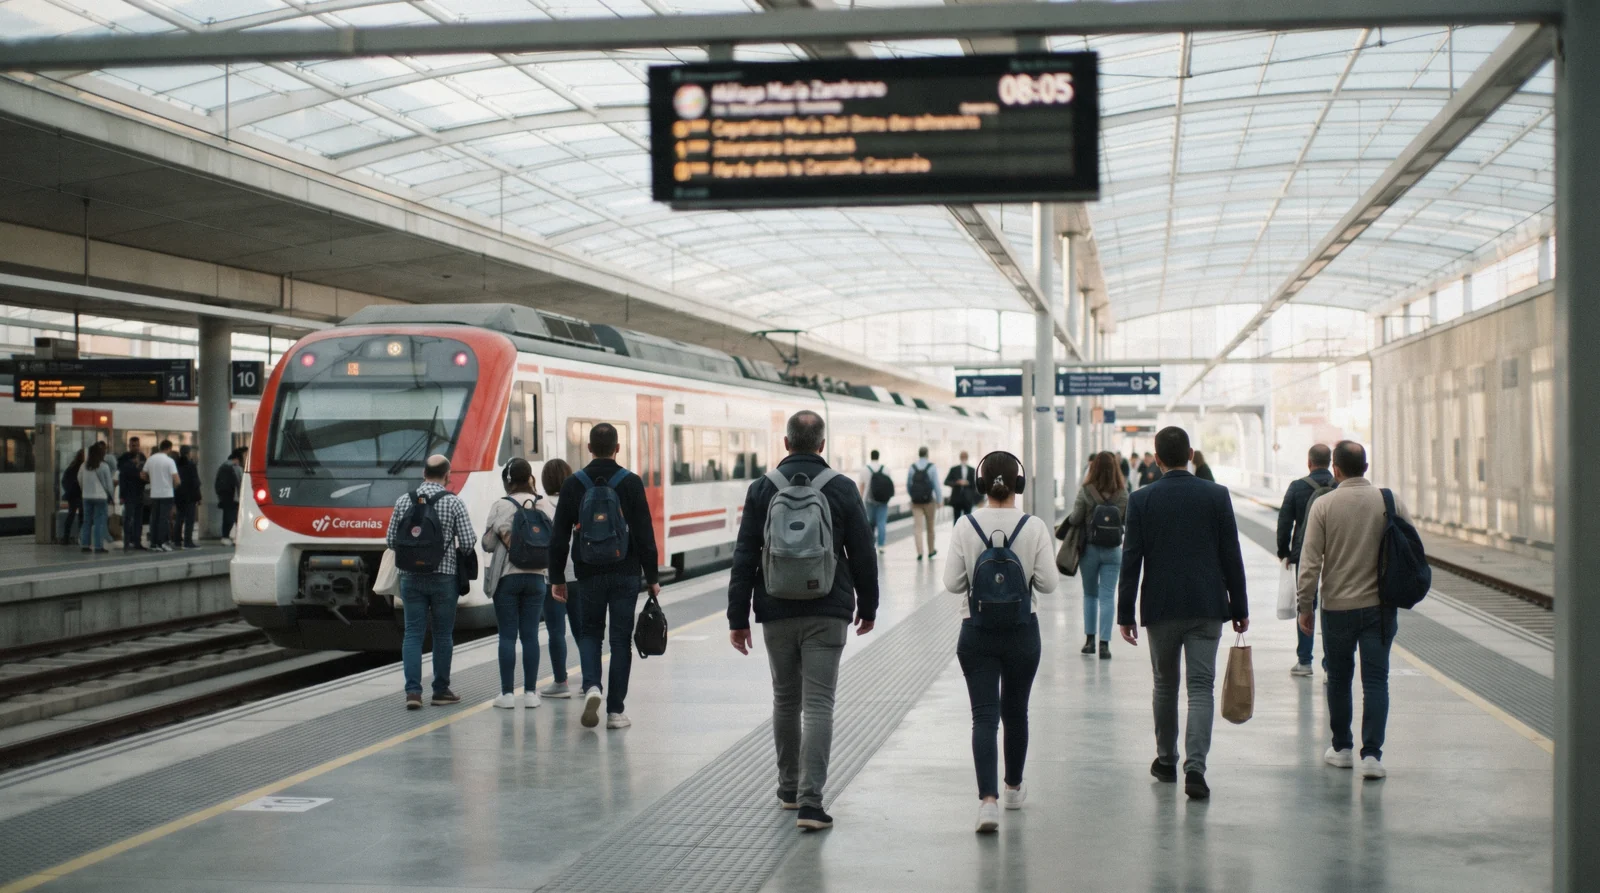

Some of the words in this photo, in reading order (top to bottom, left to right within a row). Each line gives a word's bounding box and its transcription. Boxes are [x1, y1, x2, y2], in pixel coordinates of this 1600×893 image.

[998, 72, 1074, 105] 08:05
[168, 375, 185, 391] 11
[237, 371, 255, 387] 10
[332, 517, 383, 529] Cercanías
